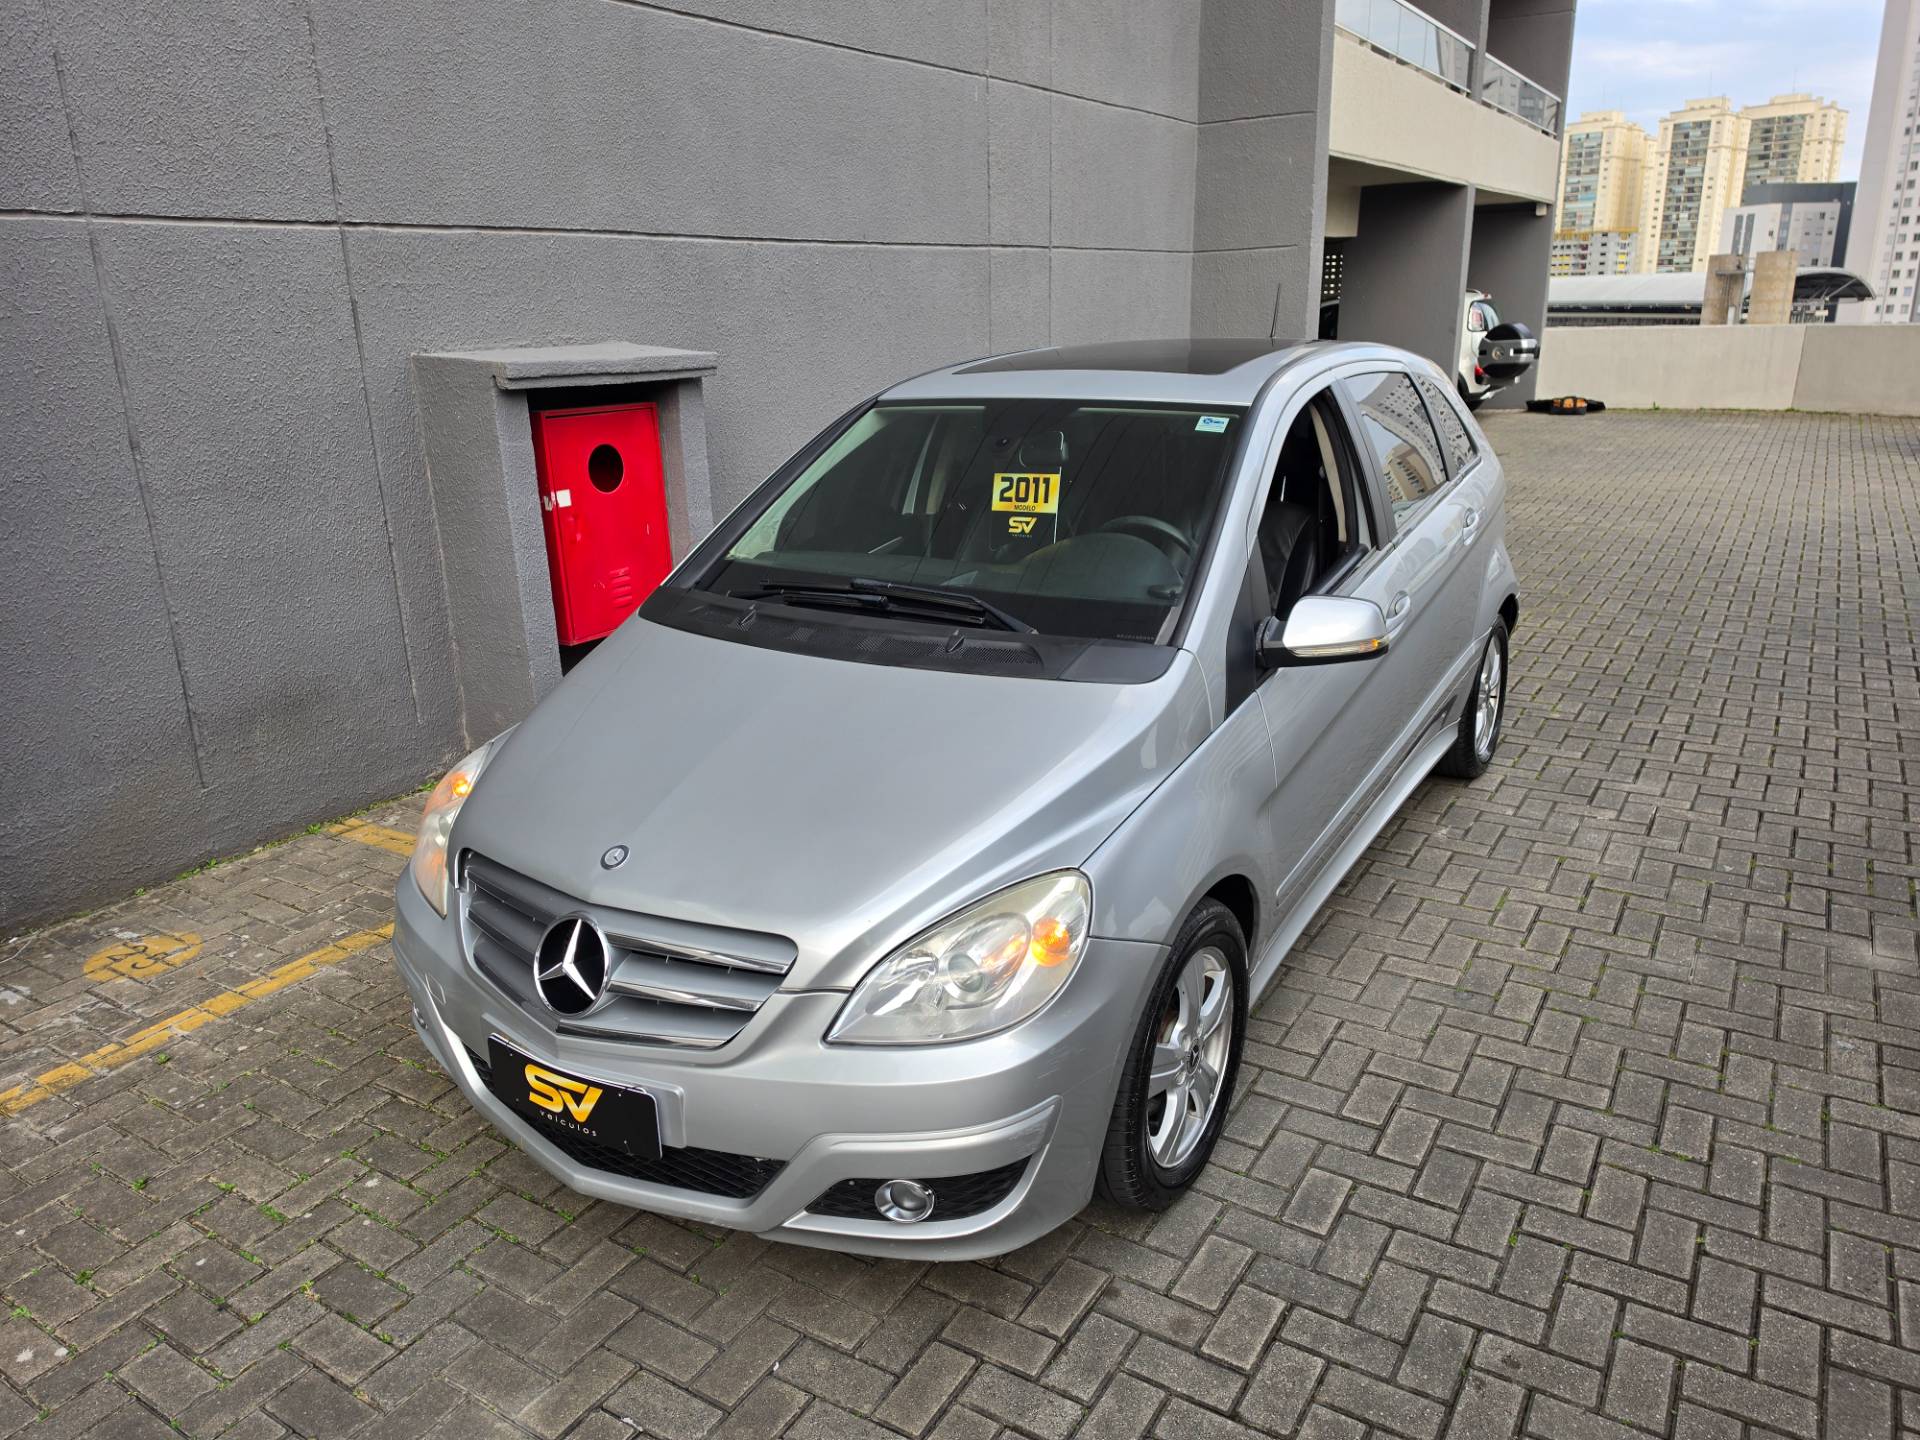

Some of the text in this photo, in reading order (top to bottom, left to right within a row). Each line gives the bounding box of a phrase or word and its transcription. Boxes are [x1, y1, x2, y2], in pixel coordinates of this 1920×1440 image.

[999, 476, 1051, 504] 2011
[1008, 516, 1037, 534] SV
[524, 1063, 603, 1123] SV
